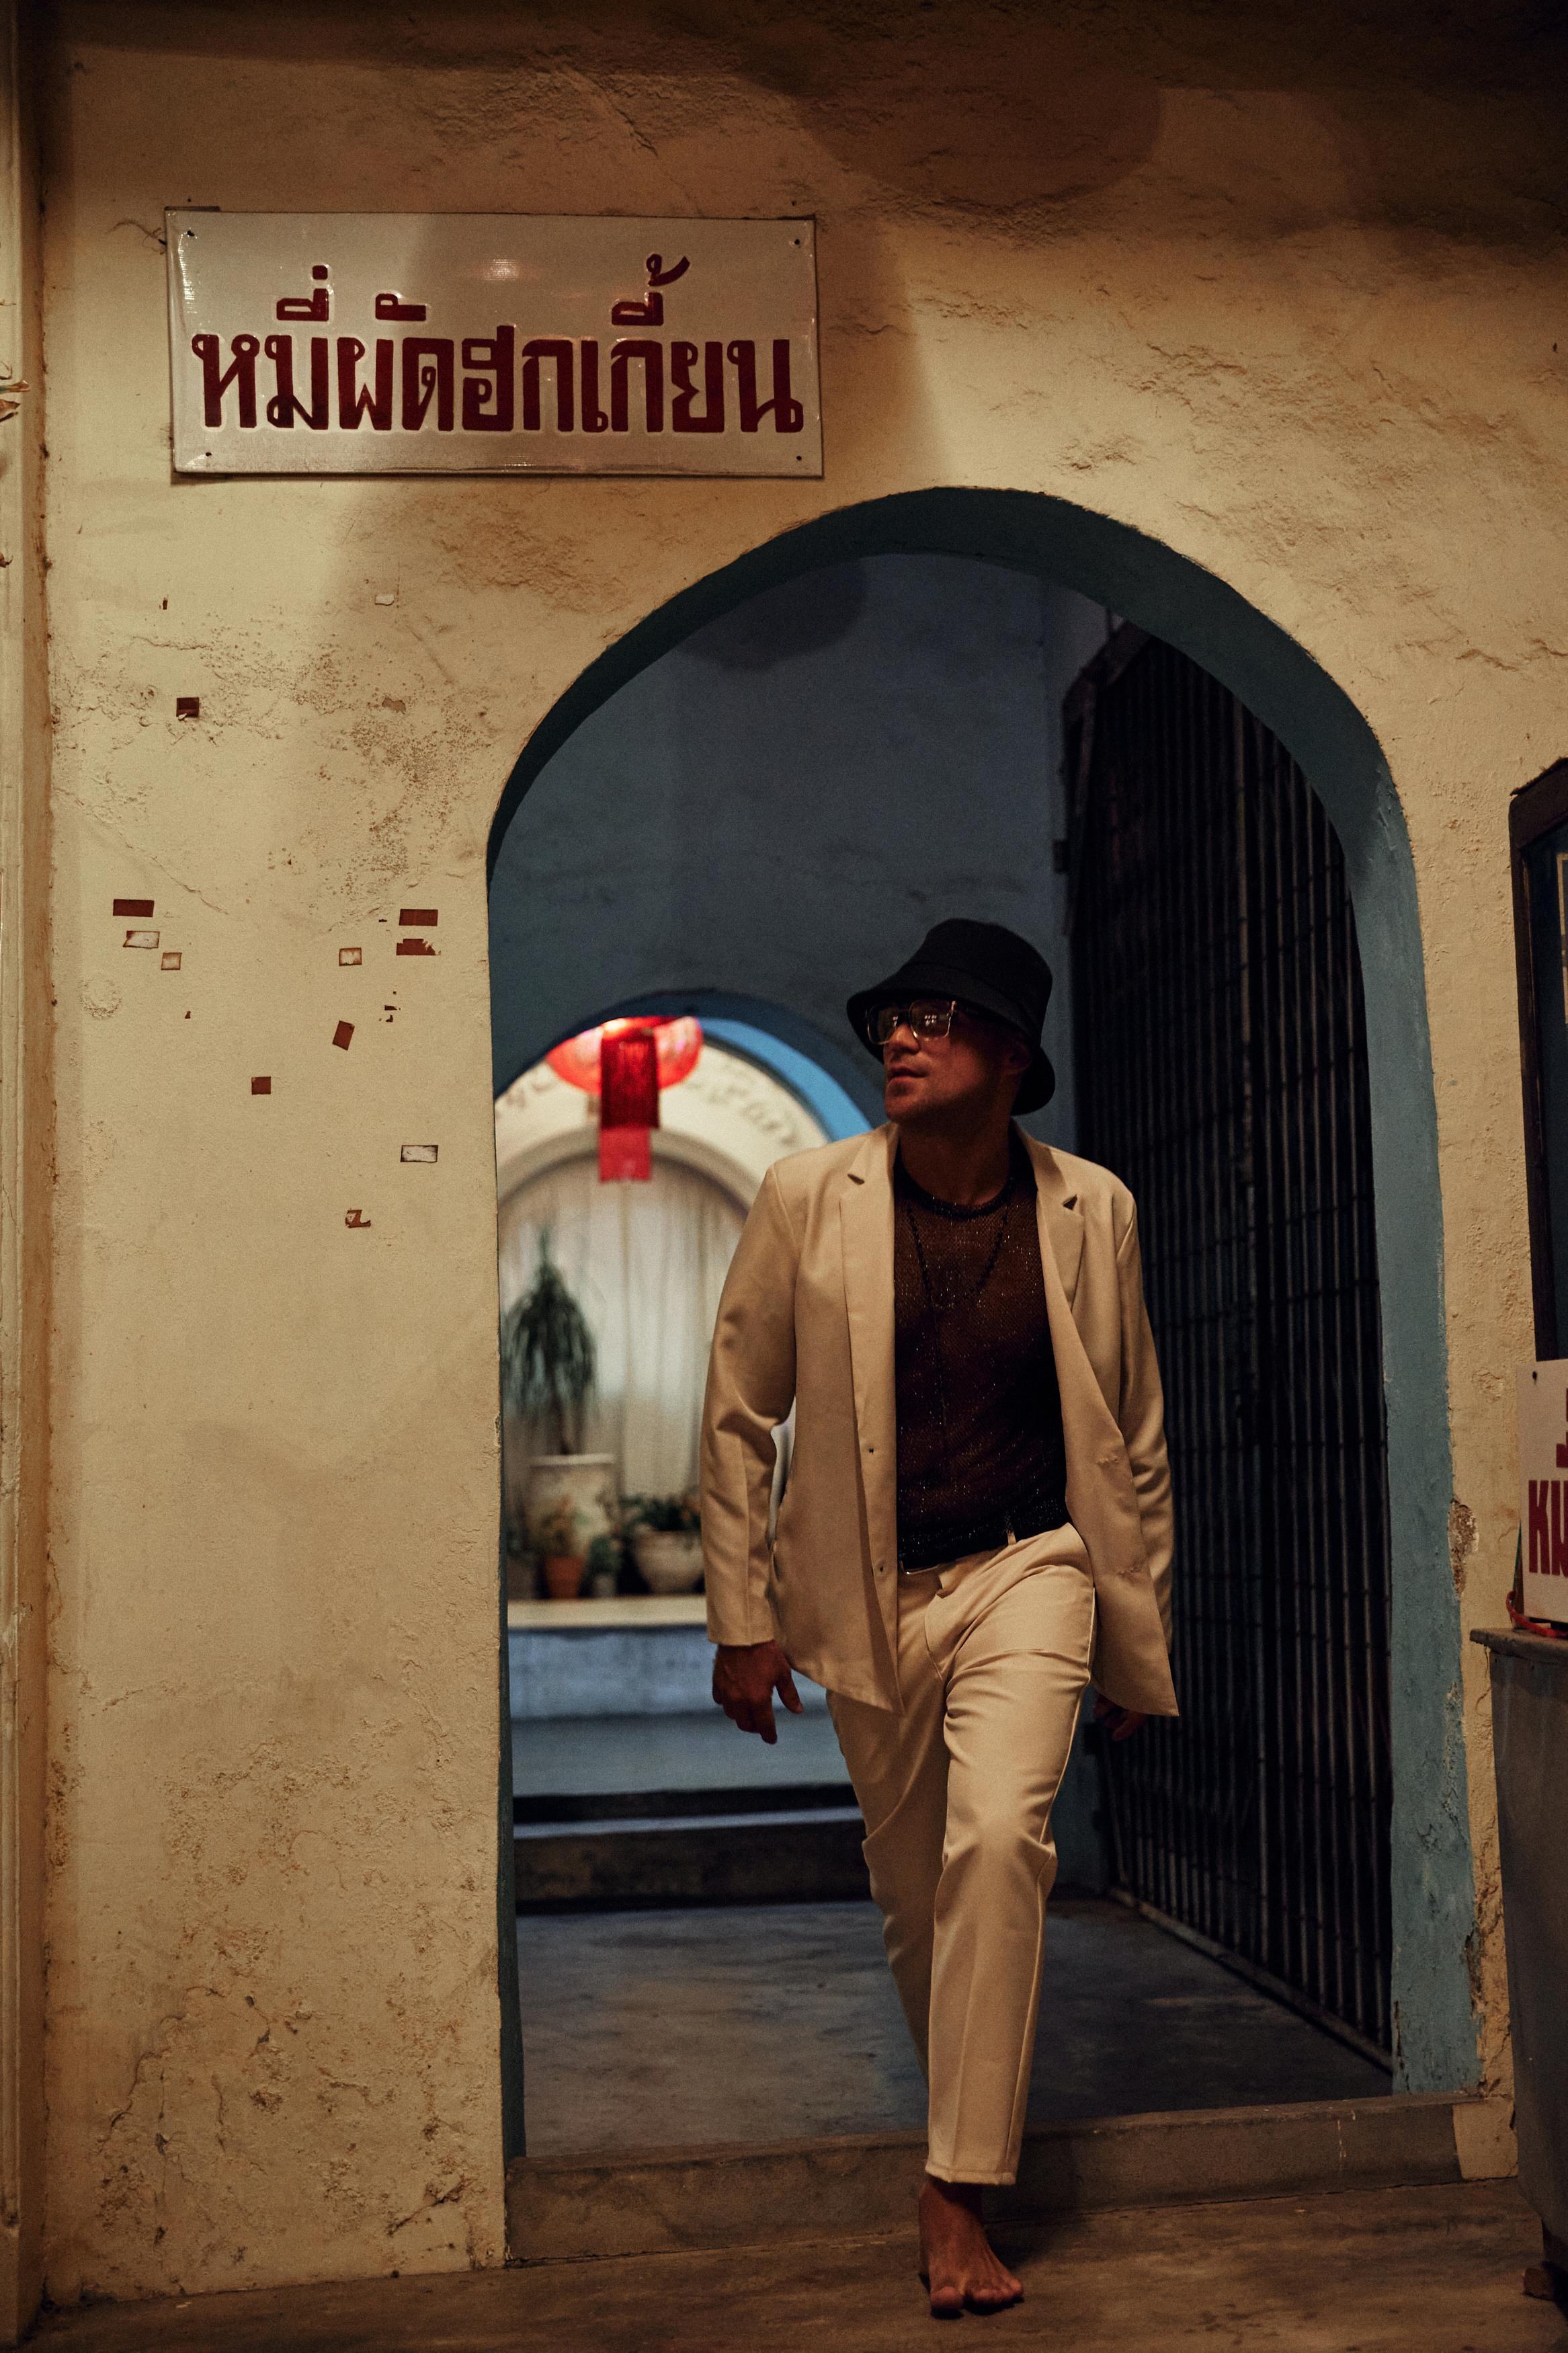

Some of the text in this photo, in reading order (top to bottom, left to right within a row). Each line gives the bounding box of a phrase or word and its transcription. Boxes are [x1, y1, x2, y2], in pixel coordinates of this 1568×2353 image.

[191, 253, 804, 434] หมี่ผัดฮกเกี้ยน
